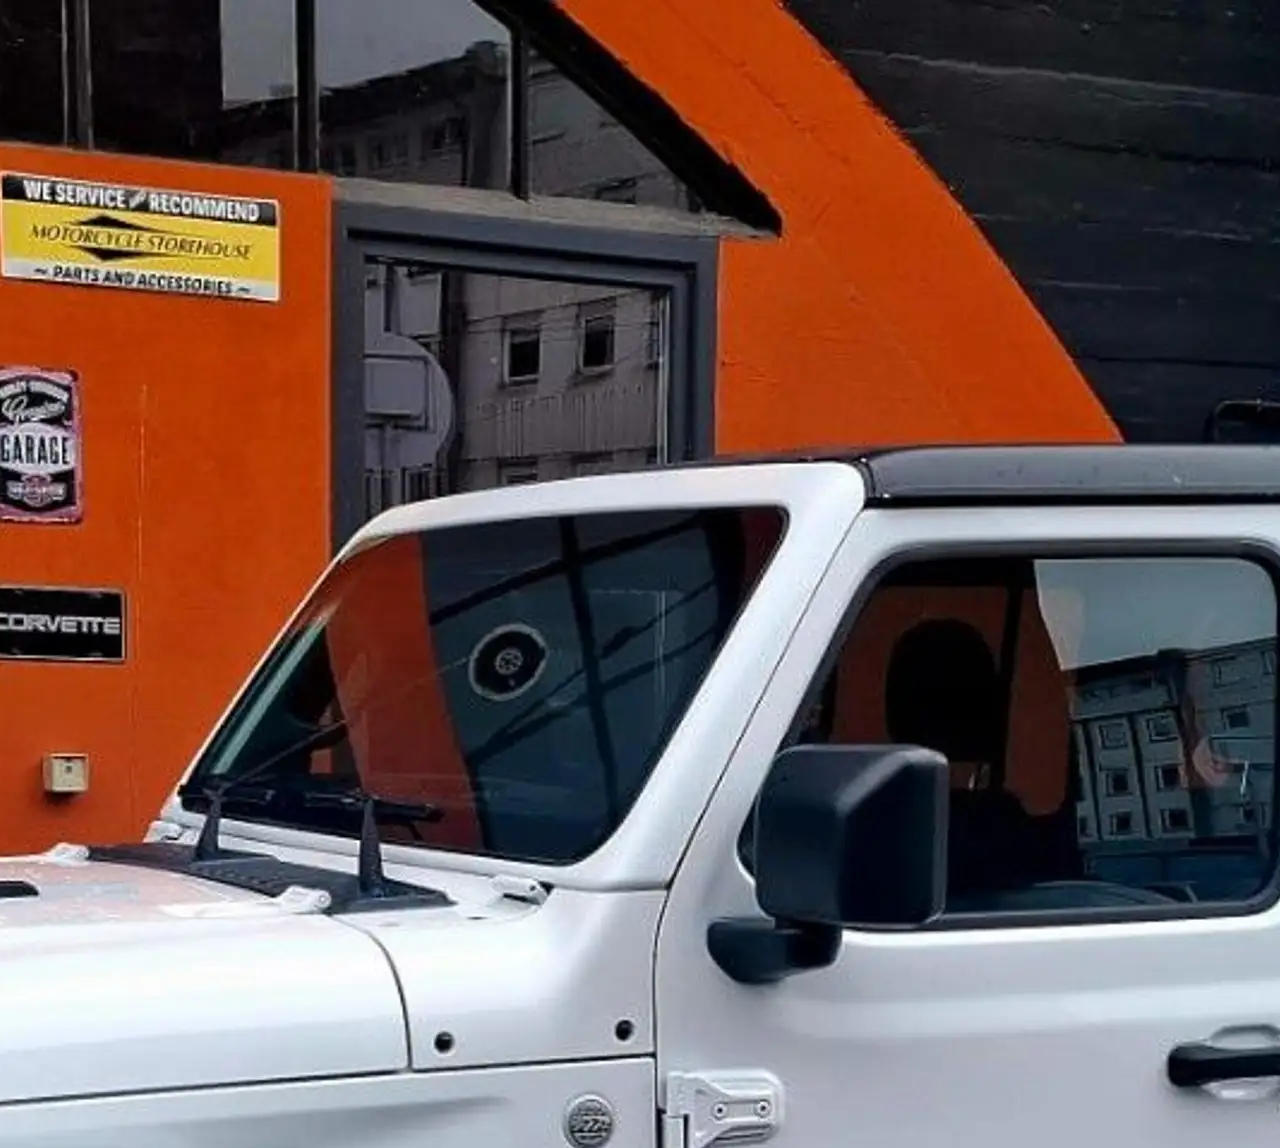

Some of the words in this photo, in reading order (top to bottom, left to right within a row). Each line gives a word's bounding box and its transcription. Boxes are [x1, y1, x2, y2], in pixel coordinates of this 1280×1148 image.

[23, 179, 52, 200] WE
[56, 183, 126, 209] SERVICE
[149, 193, 260, 222] RECOMMEND
[29, 223, 142, 248] MOTORCYCLE
[147, 234, 253, 259] STOREHOUSE
[53, 265, 99, 284] PARTS
[102, 270, 136, 287] AND
[137, 271, 233, 295] ACCESSORIES
[0, 434, 70, 465] GARAGE
